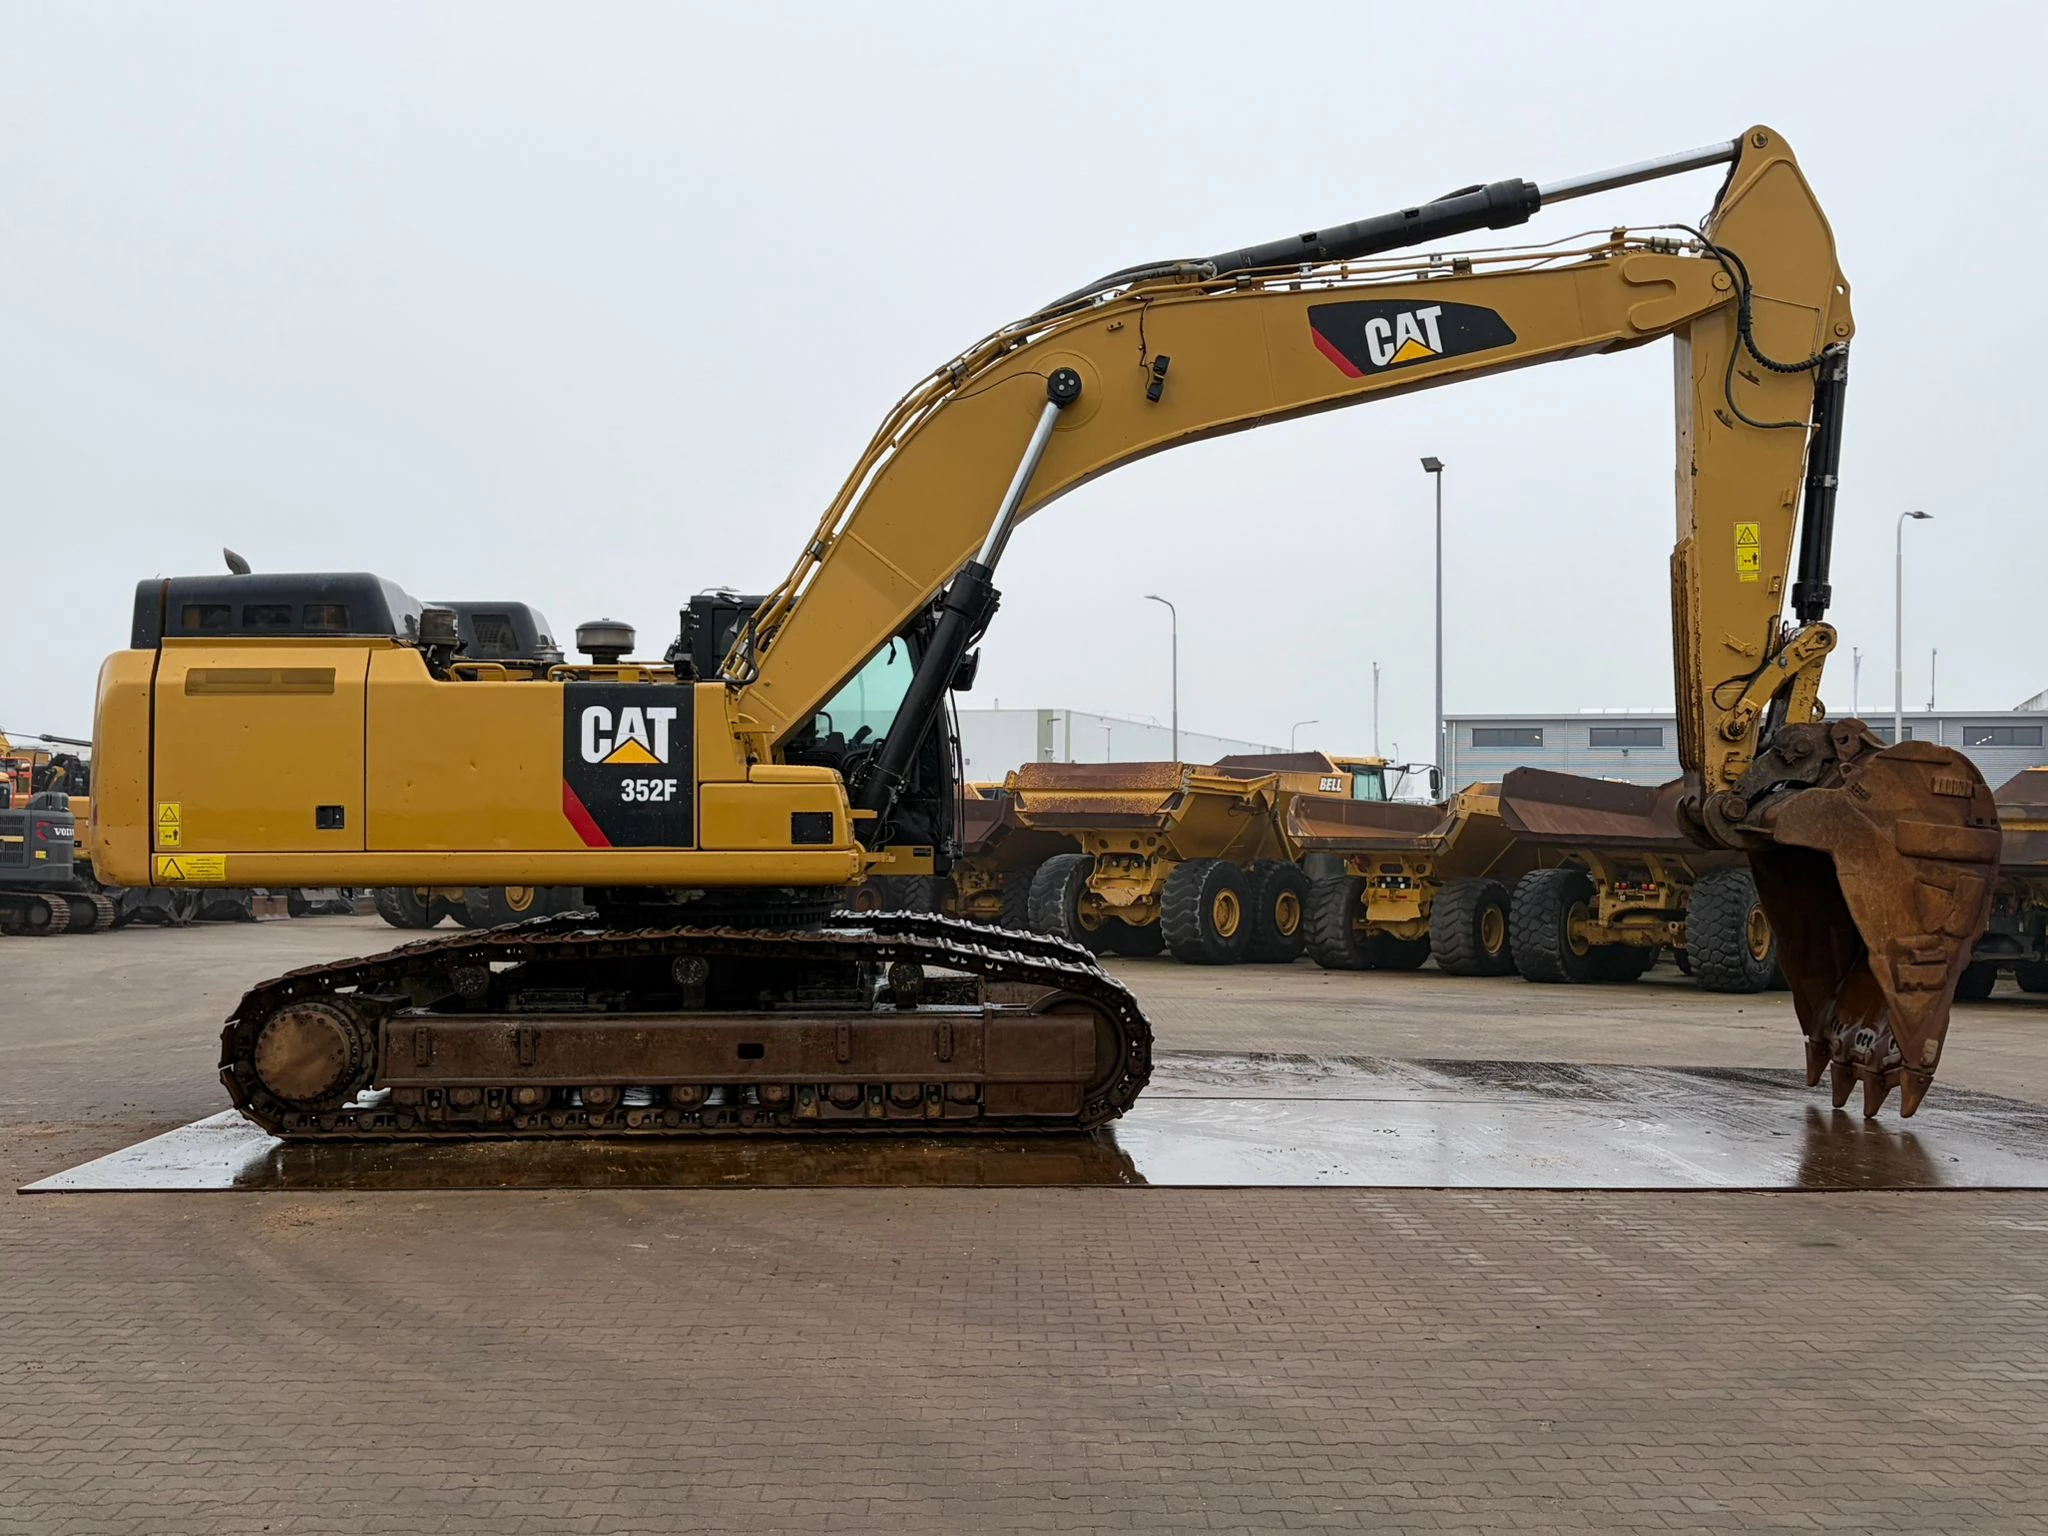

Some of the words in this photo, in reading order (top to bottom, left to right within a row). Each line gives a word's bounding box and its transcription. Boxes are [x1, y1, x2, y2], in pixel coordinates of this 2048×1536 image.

[1364, 305, 1443, 366] CAT
[581, 705, 677, 764] CAT
[621, 779, 677, 802] 352F
[1319, 777, 1342, 791] BELL
